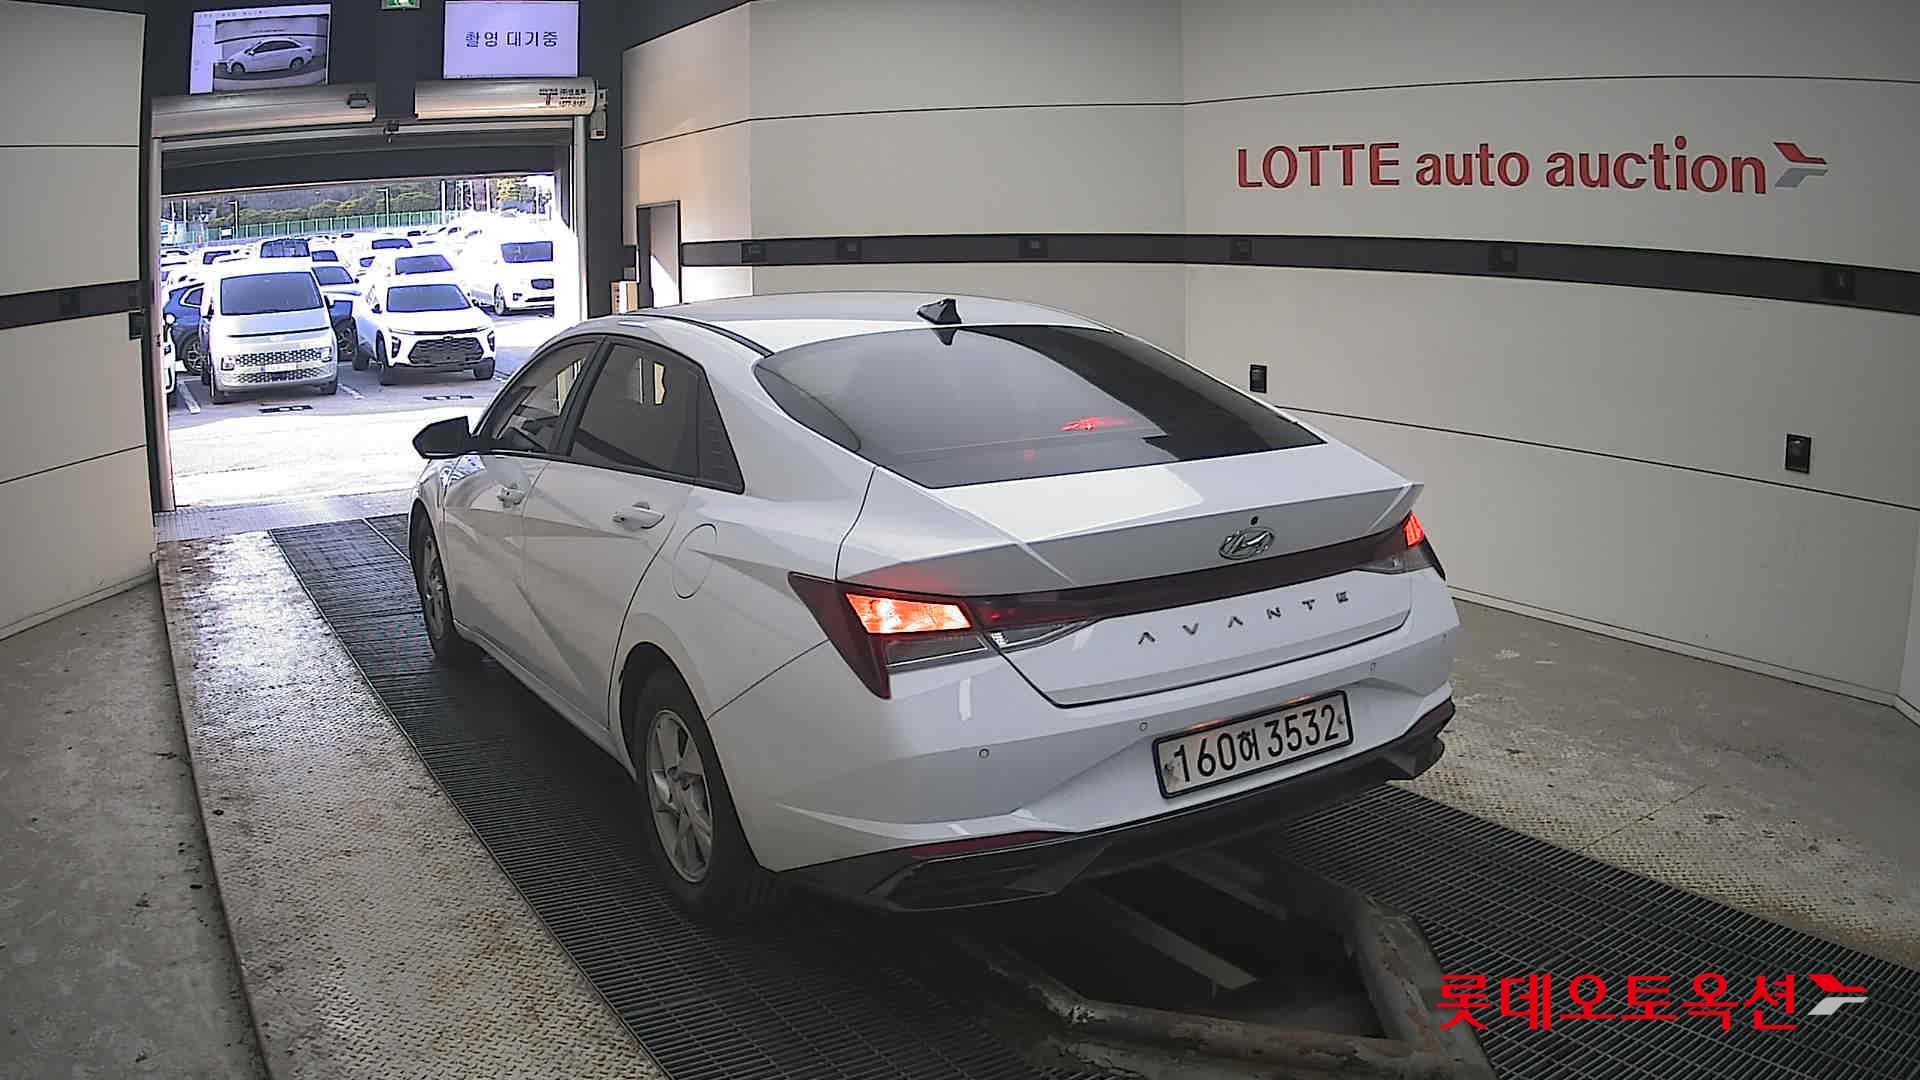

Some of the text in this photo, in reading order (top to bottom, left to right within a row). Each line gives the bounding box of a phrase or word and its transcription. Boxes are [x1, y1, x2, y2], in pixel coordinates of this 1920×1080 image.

[465, 31, 558, 48] 촬영 대기중
[1238, 136, 1767, 194] LOTTE auto auction
[1138, 591, 1349, 645] AVANTE
